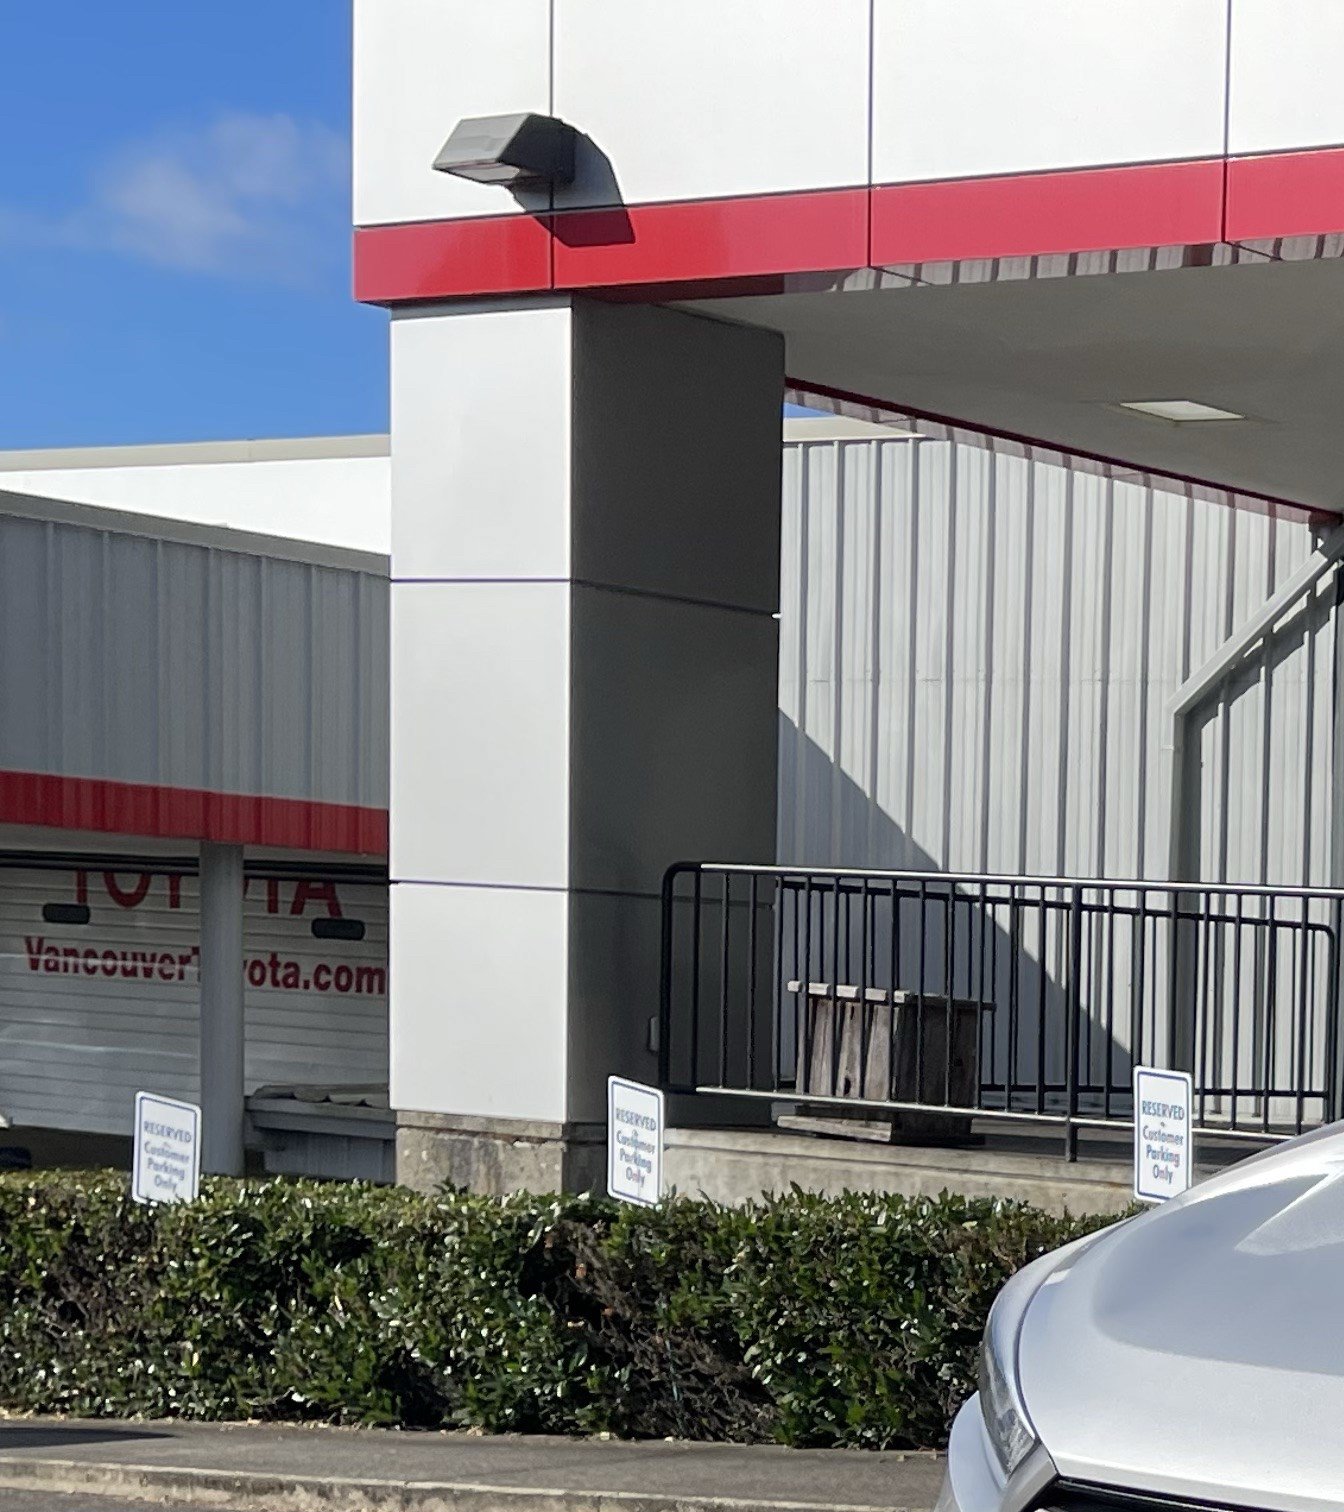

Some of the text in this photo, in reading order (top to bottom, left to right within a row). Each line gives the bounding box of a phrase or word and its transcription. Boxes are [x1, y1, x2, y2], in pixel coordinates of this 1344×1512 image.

[1141, 1099, 1185, 1121] RESERVED
[1142, 1124, 1184, 1146] Customer
[1145, 1143, 1181, 1168] Parking
[1152, 1163, 1174, 1185] Only
